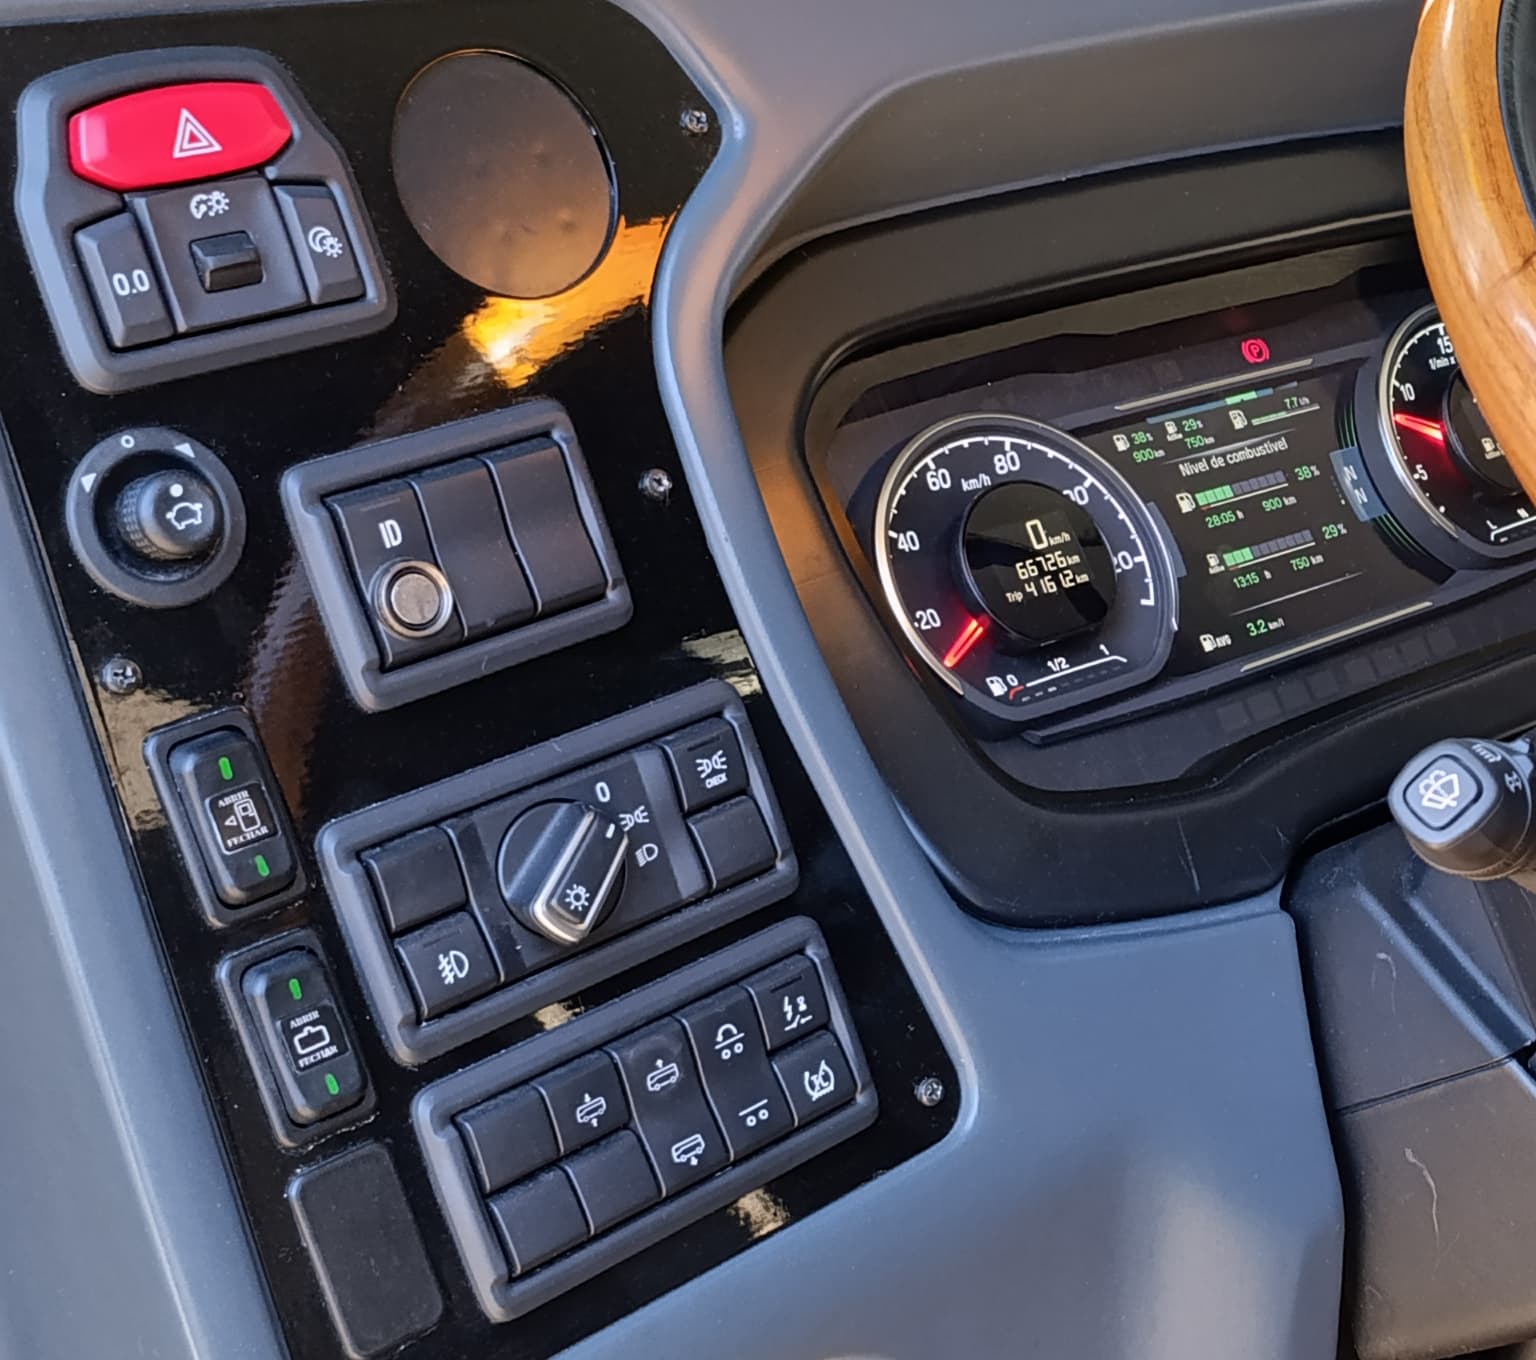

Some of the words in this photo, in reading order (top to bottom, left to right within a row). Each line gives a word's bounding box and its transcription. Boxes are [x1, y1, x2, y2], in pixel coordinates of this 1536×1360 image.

[112, 269, 151, 296] 0.0
[1436, 335, 1454, 355] 15
[1400, 383, 1415, 402] 10
[1182, 418, 1197, 432] 29
[1131, 431, 1146, 445] 38
[1184, 435, 1205, 449] 750
[993, 450, 1020, 475] 80
[1132, 448, 1154, 463] 900
[1210, 455, 1226, 468] de
[926, 468, 951, 491] 60
[1294, 466, 1312, 481] 38
[1343, 465, 1358, 481] N
[961, 473, 992, 492] km/h
[1262, 497, 1283, 512] 900
[1353, 487, 1369, 504] N
[1205, 510, 1236, 528] 28:05
[897, 530, 920, 552] 40
[1025, 518, 1049, 550] 0
[1322, 524, 1338, 540] 29
[1015, 551, 1067, 580] 66726
[1290, 556, 1310, 571] 750
[1233, 571, 1260, 589] 13:15
[1005, 591, 1023, 603] Trip
[916, 608, 941, 630] 20
[1246, 618, 1268, 637] 3.2
[1099, 644, 1110, 655] 1
[1047, 657, 1070, 672] 1/2
[1006, 674, 1018, 687] 0
[705, 772, 728, 789] CHECK
[217, 790, 250, 808] ABRIR
[226, 825, 269, 848] FECHAR
[289, 1010, 320, 1030] ABRIR
[298, 1045, 338, 1068] FECHAR
